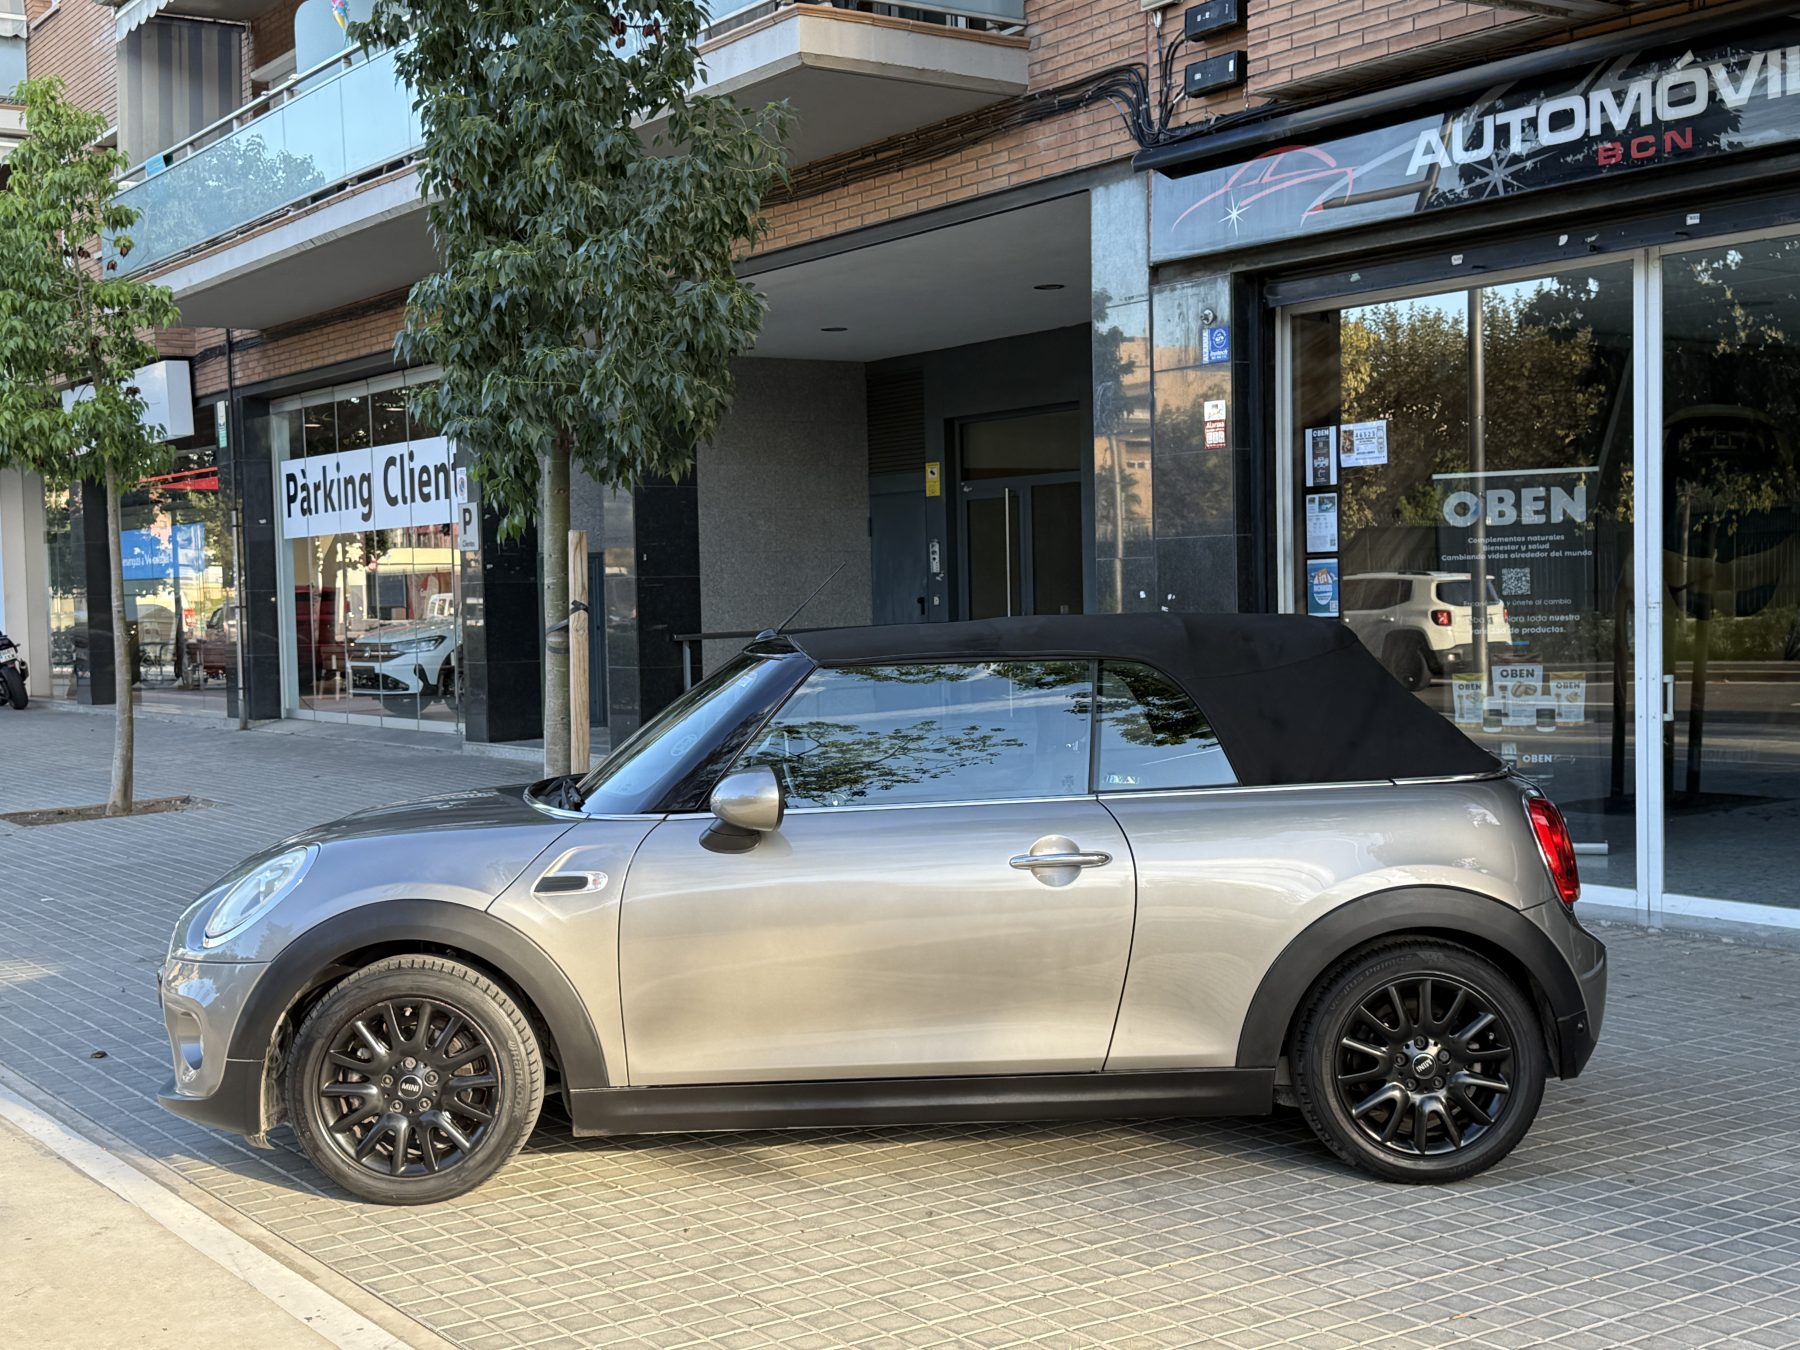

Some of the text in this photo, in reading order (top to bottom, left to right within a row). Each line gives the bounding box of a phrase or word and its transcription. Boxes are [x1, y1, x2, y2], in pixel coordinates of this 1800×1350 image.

[1598, 127, 1693, 166] BCN
[286, 461, 373, 522] Pàrking
[1443, 486, 1587, 528] OBEN
[462, 508, 472, 535] P
[1468, 534, 1565, 545] Complementos naturales
[1482, 544, 1519, 552] Bienestar
[1441, 549, 1593, 561] Cambiando vidas alrededor del mundo
[1543, 598, 1572, 606] cambio
[1527, 614, 1547, 622] toda
[1549, 613, 1580, 621] nuestra
[1522, 626, 1566, 635] productos.
[1500, 668, 1535, 678] OBEN
[1458, 683, 1482, 691] OBEN
[1555, 681, 1580, 689] OBEN
[1522, 754, 1552, 763] OBEN
[1415, 1059, 1433, 1073] MINI
[401, 1082, 419, 1092] MINI
